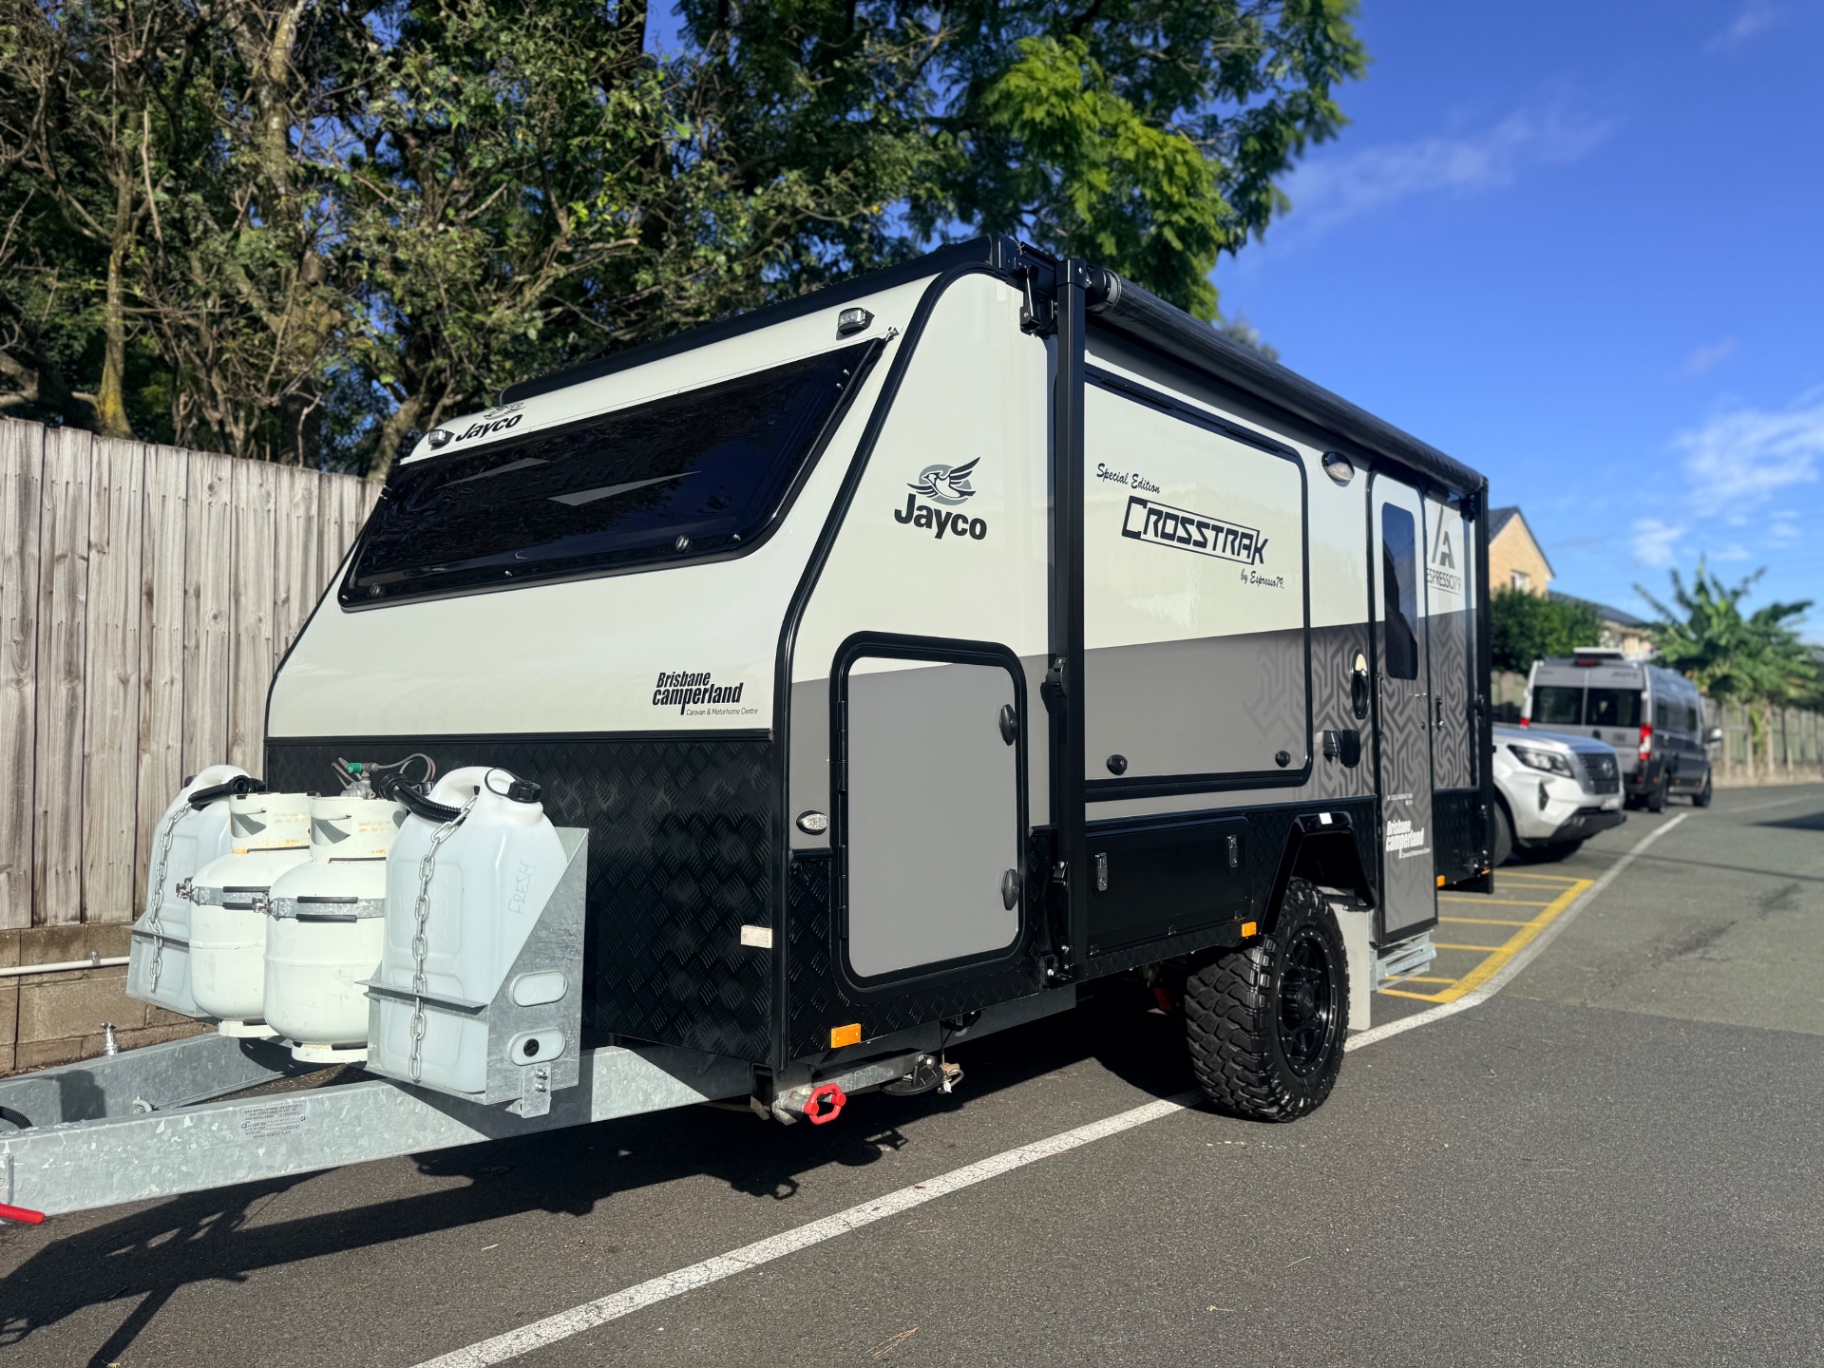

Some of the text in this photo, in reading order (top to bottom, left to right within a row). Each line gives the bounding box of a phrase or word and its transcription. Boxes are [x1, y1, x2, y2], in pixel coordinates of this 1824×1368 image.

[455, 414, 524, 442] Jayco
[1096, 462, 1161, 494] Special Edition
[893, 492, 988, 541] Jayco
[1121, 495, 1269, 566] CROSSTRAK
[1240, 568, 1249, 585] by
[656, 671, 711, 688] Brisbane
[651, 682, 744, 716] camperland
[686, 707, 759, 716] Caravan & Motorhome Centre
[1386, 827, 1424, 859] camperland
[1387, 820, 1411, 836] Brisbane
[508, 860, 536, 914] FRESH
